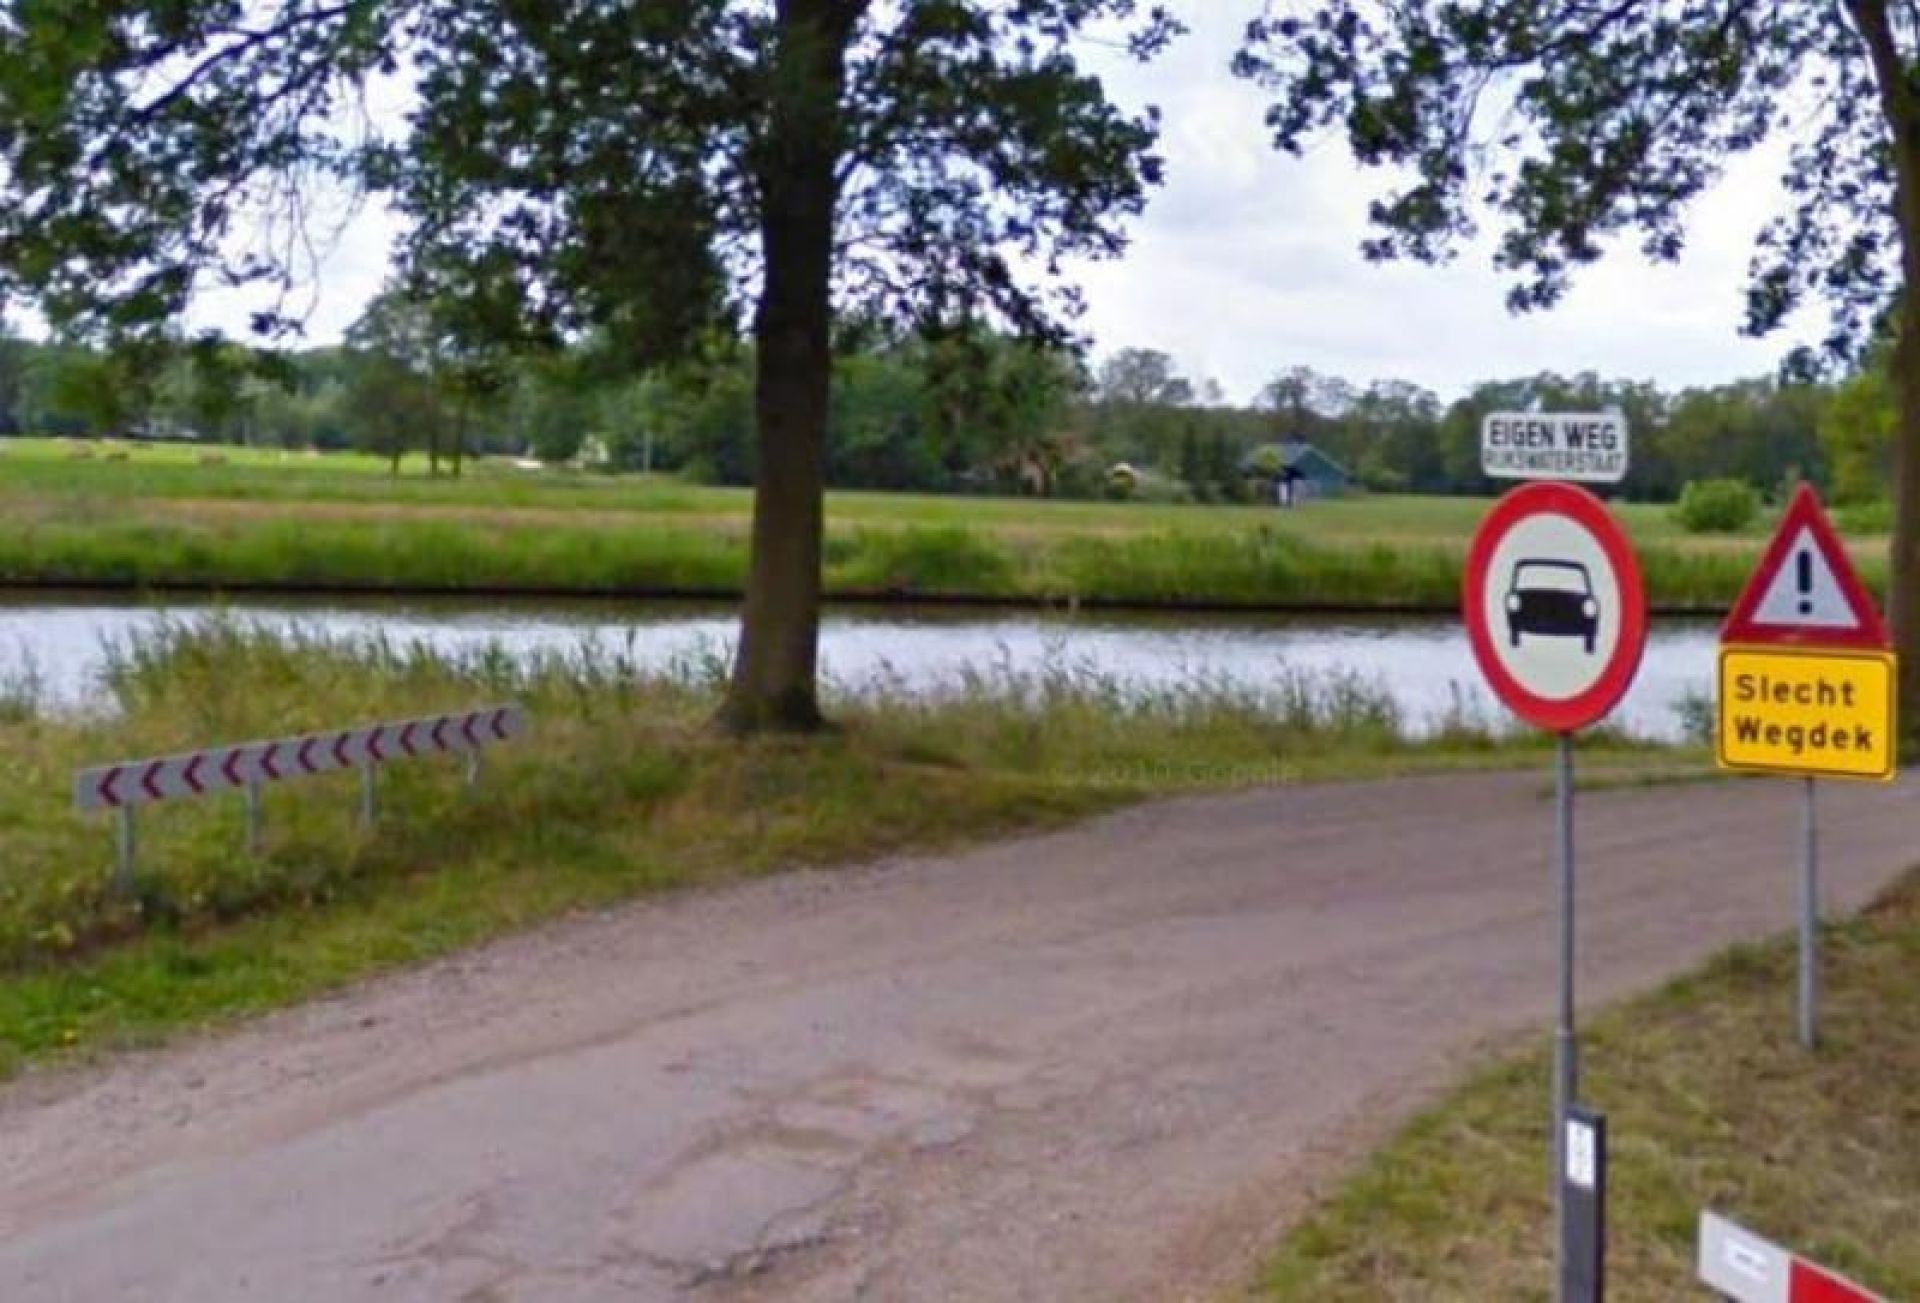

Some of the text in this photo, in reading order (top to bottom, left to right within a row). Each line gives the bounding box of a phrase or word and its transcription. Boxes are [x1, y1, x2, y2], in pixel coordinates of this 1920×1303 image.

[1490, 420, 1617, 449] EIGEN WEG
[1735, 673, 1855, 707] Slecht
[1734, 715, 1872, 755] Wegdek
